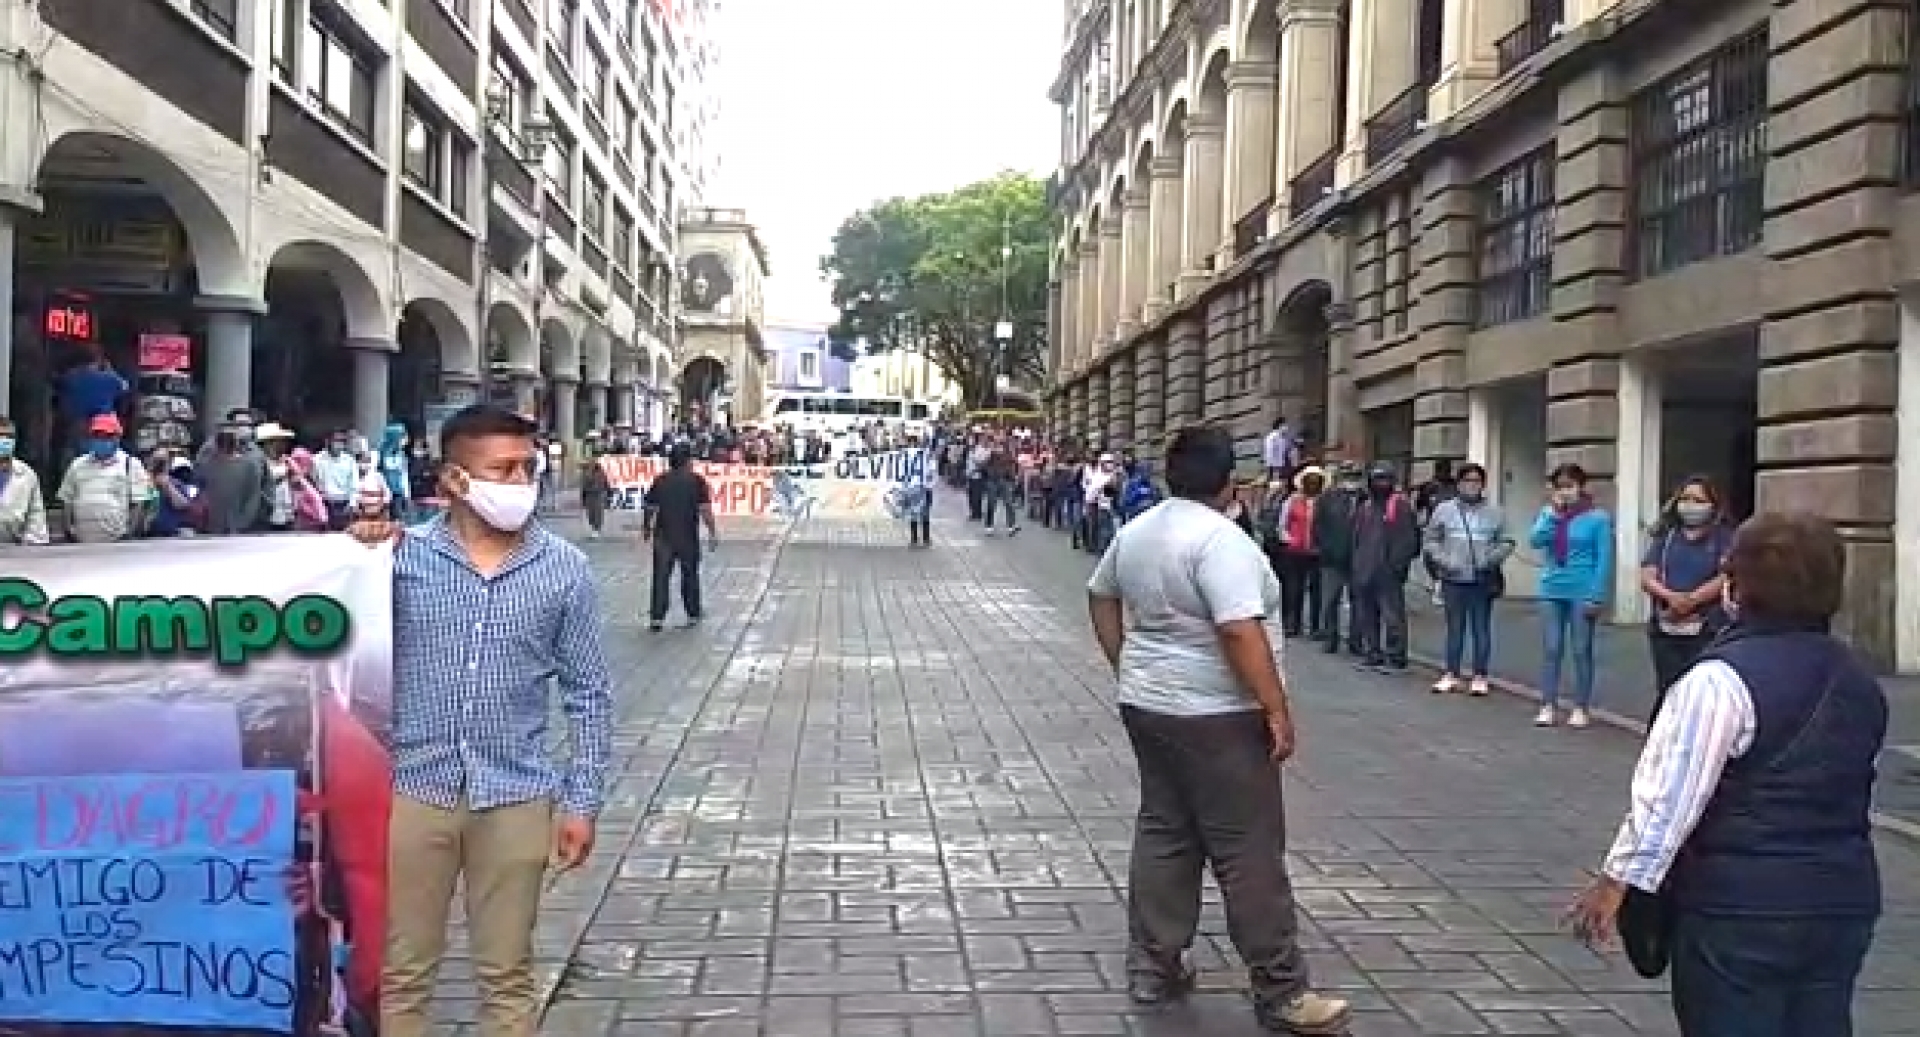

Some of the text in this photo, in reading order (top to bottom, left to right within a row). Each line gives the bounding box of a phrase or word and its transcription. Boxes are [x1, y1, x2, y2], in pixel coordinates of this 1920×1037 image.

[0, 577, 351, 665] Campo
[193, 856, 274, 906] DE
[60, 907, 142, 940] LOS
[0, 938, 296, 1008] MPESINOS
